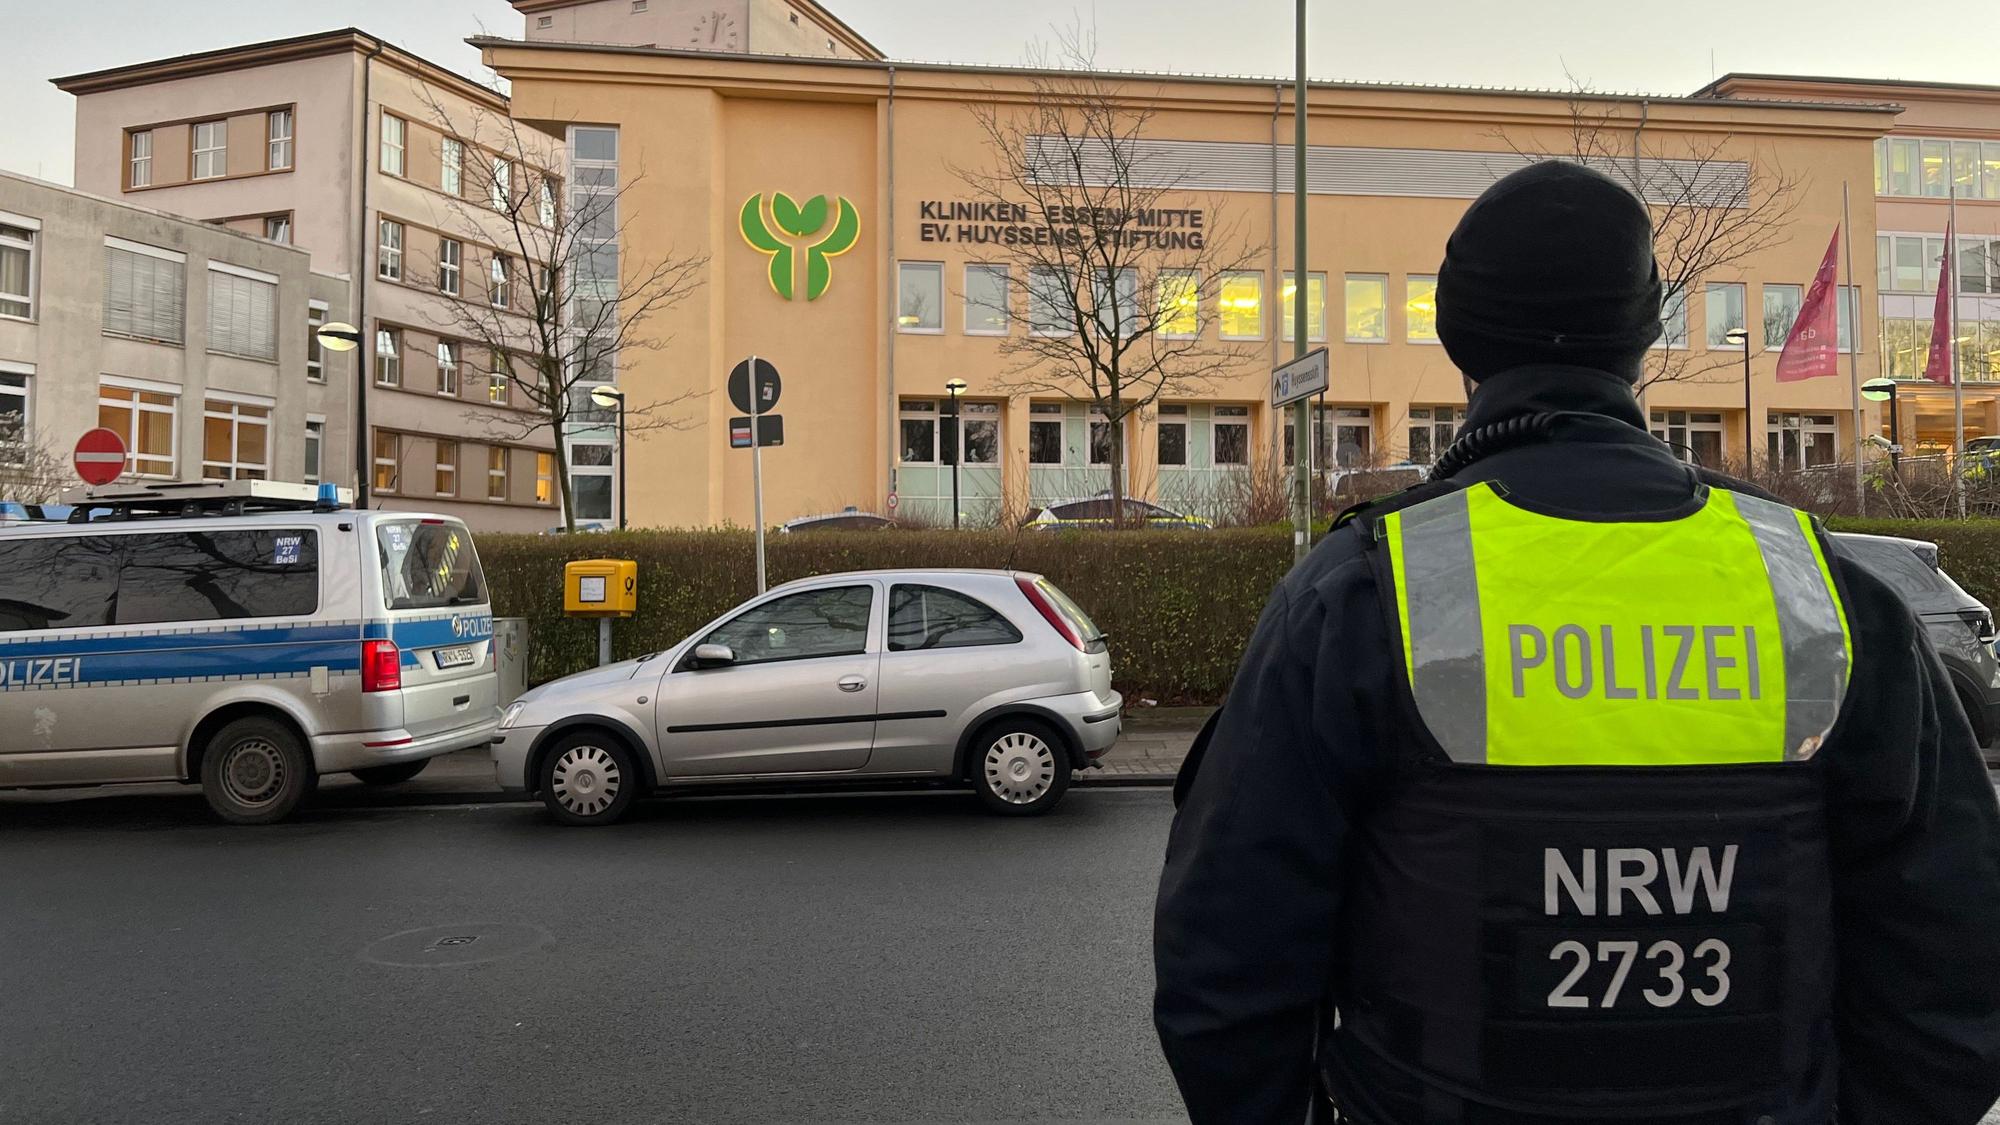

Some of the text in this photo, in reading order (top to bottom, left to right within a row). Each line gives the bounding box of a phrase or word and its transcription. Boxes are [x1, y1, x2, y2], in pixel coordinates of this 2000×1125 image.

[920, 200, 1026, 222] KLINIKEN
[920, 223, 951, 242] EV.
[276, 536, 301, 546] NRW
[282, 546, 294, 555] 27
[1508, 623, 1760, 700] POLIZEI
[1544, 845, 1739, 916] NRW
[1547, 938, 1732, 1008] 2733
